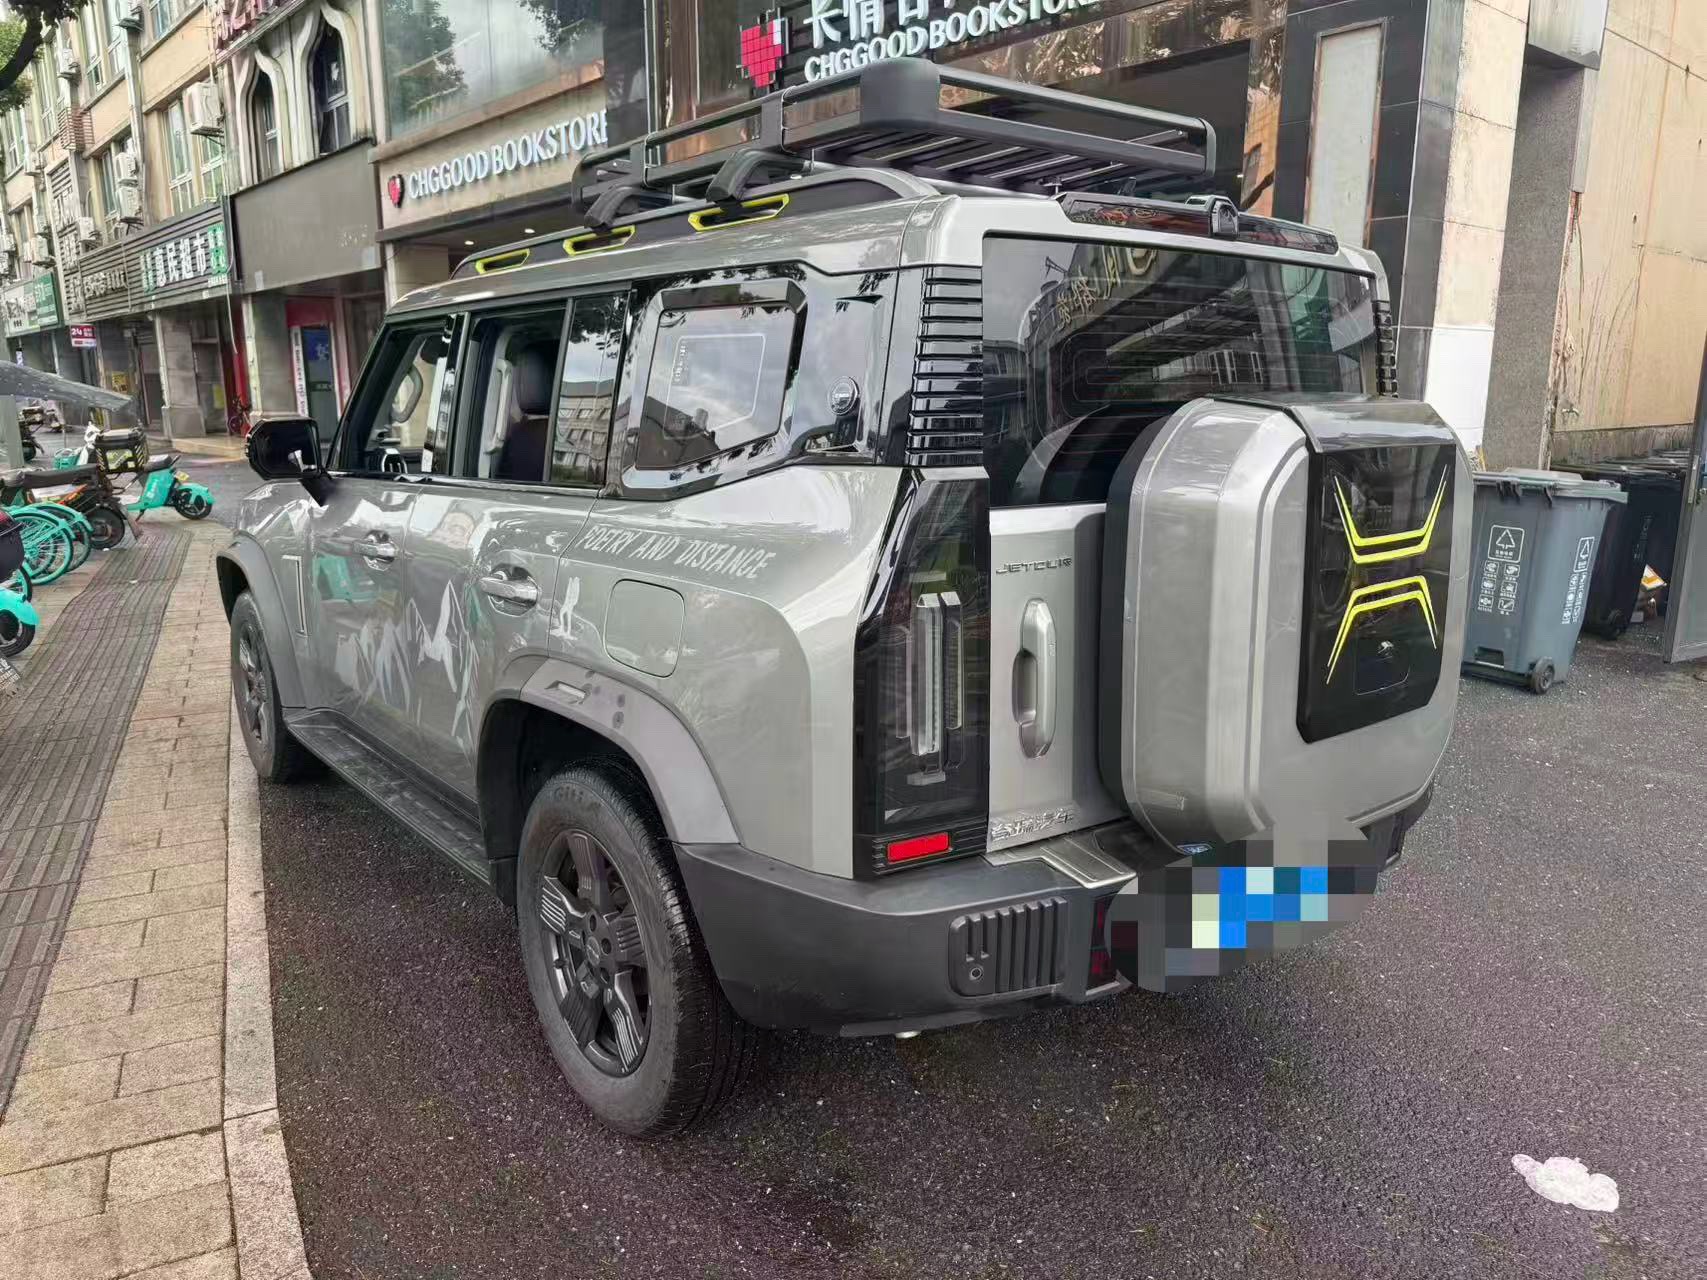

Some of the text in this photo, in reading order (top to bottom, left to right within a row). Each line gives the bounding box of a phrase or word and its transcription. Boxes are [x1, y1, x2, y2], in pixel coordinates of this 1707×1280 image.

[804, 0, 1100, 83] CHGGOOD BOOKST
[408, 149, 490, 200] CHGGOOD
[576, 525, 777, 579] POETRY AND DISTANCE
